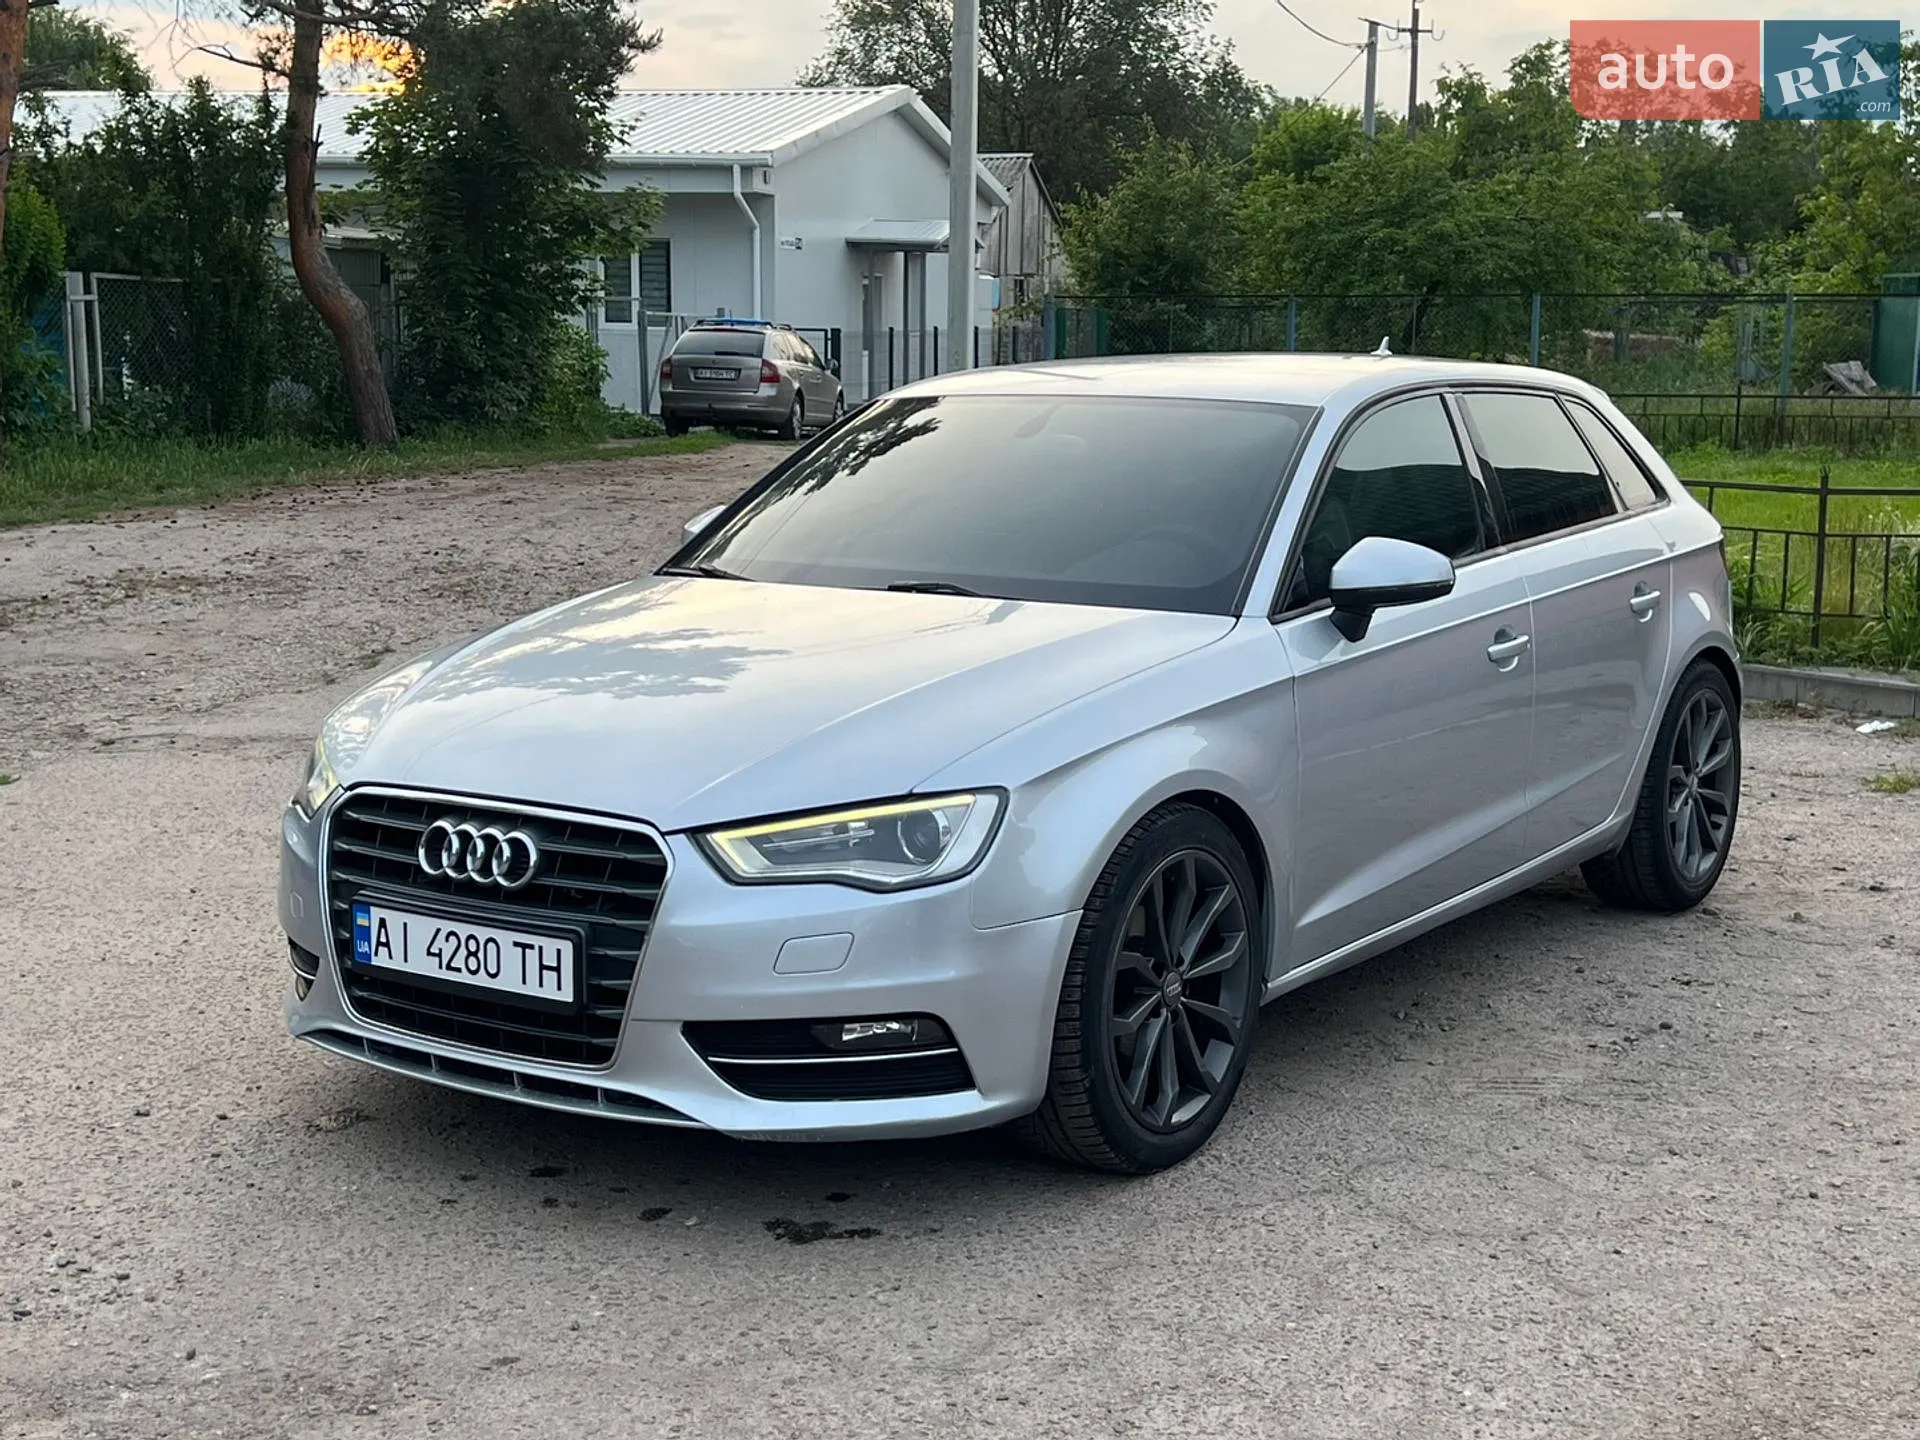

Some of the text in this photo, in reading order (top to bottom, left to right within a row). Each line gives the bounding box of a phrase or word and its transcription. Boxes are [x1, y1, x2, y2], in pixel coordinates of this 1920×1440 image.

[356, 940, 370, 954] UA
[374, 917, 562, 991] AI 4280 TH
